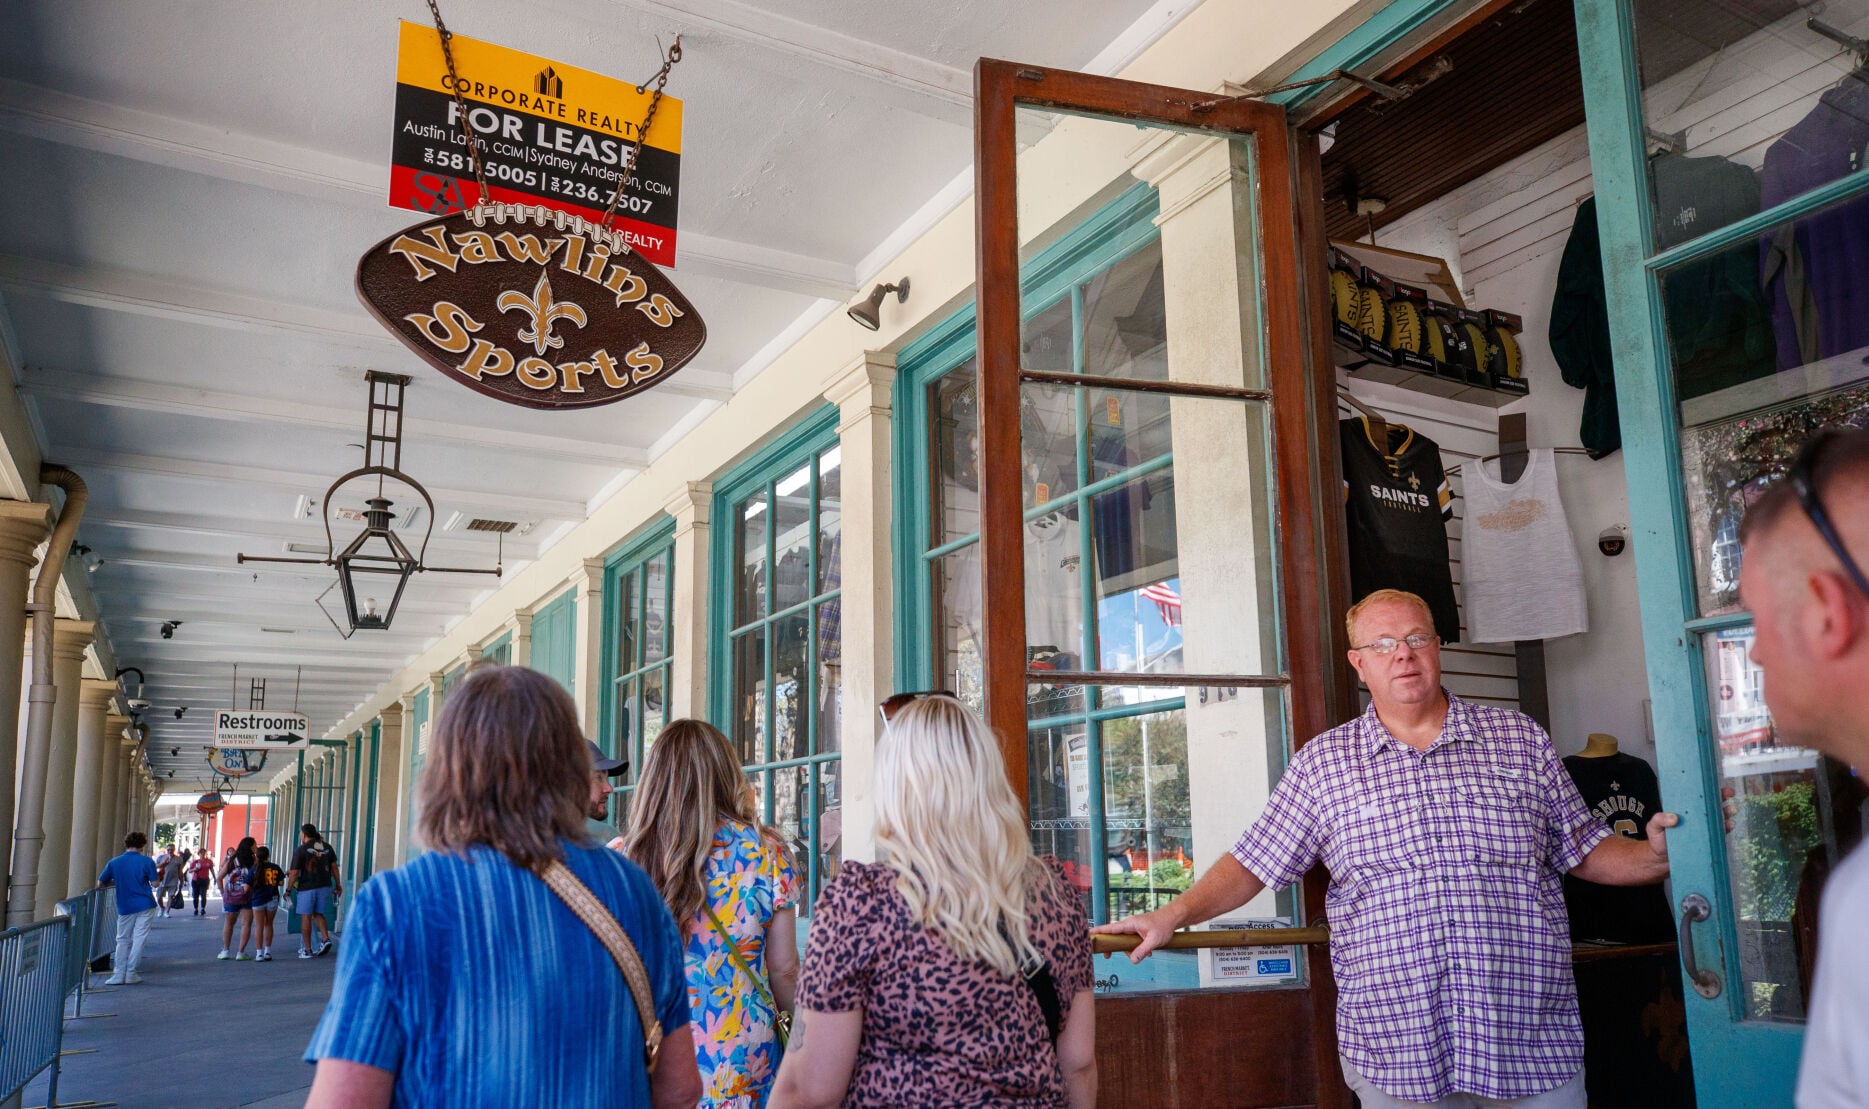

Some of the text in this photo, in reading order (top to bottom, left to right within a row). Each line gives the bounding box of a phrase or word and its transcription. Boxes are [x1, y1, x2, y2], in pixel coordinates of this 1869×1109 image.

[441, 74, 566, 118] CORPORATE
[447, 101, 637, 171] FOR LEASE
[403, 119, 446, 141] Austin
[450, 130, 489, 153] Lain,
[493, 142, 524, 159] CCIM
[530, 149, 578, 174] Sydney
[645, 180, 673, 197] CCIM
[436, 150, 537, 187] 5815005
[389, 225, 685, 328] Nawlins
[403, 300, 665, 394] Sports
[1370, 484, 1430, 507] SAINTS
[219, 713, 306, 731] Restrooms
[1591, 795, 1646, 823] SHOUGH
[1248, 922, 1275, 930] Access
